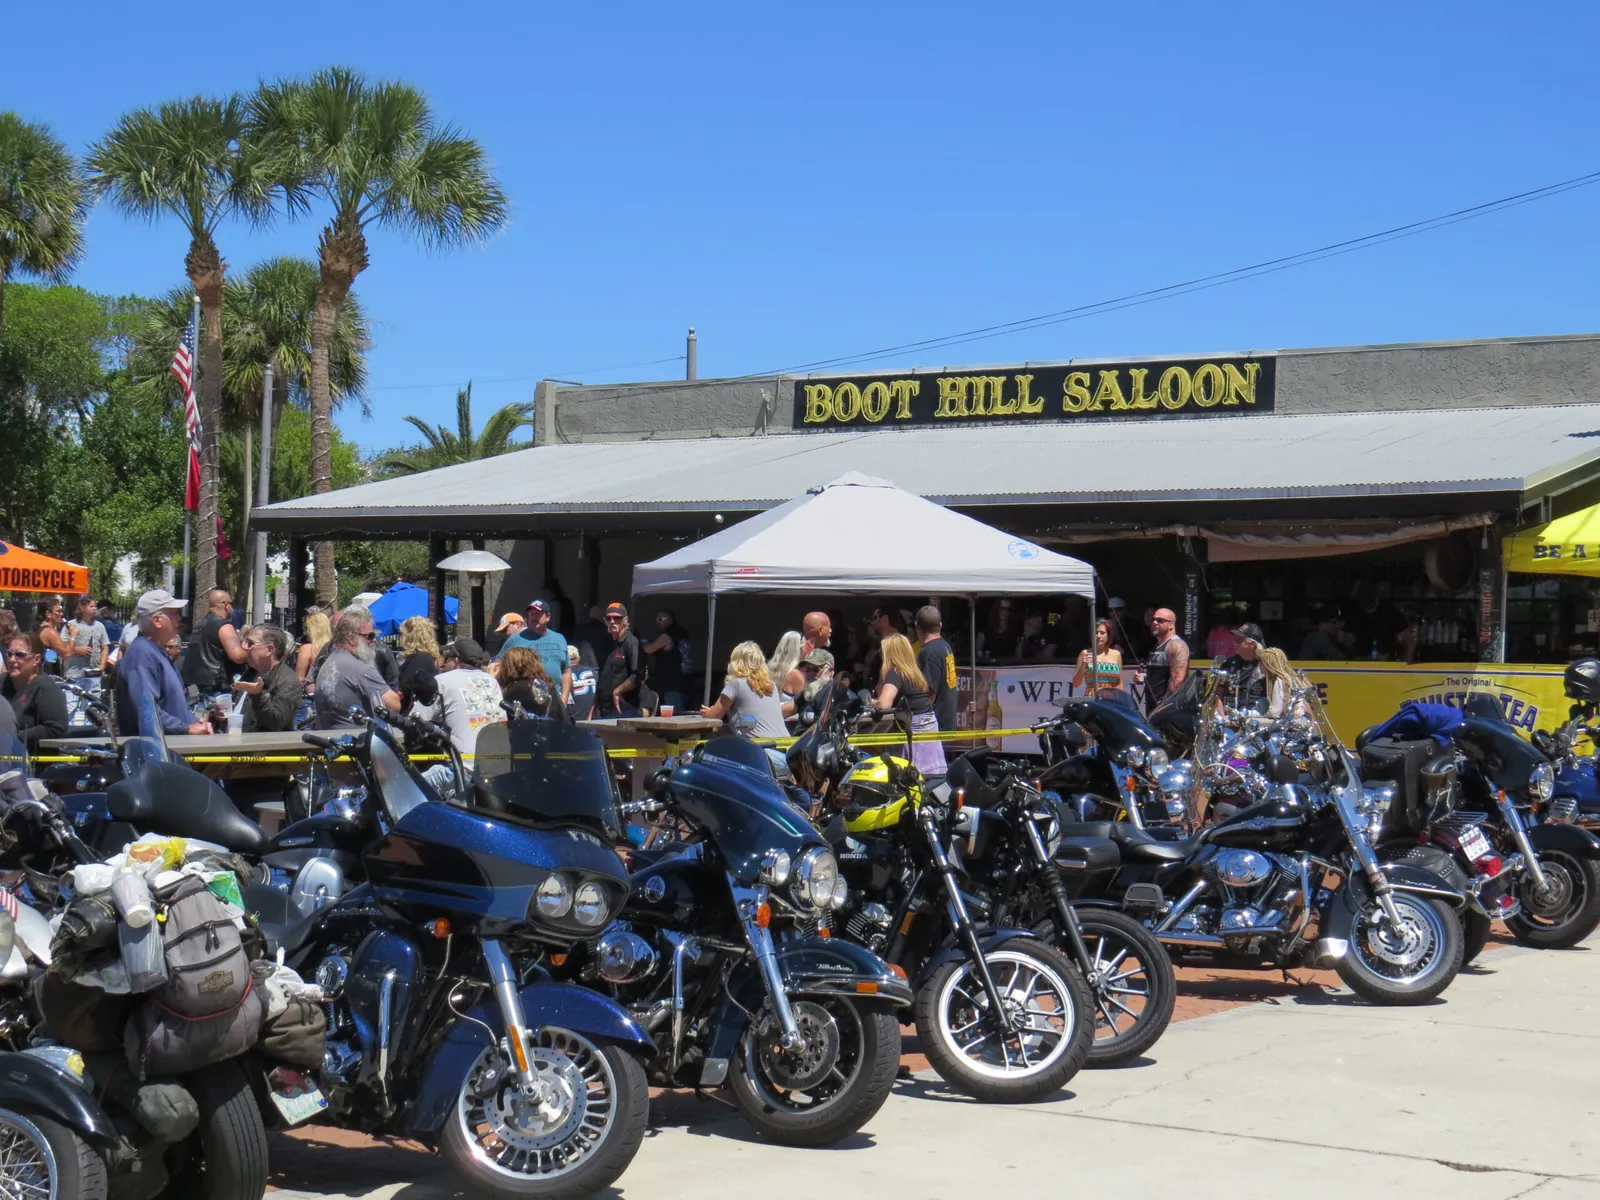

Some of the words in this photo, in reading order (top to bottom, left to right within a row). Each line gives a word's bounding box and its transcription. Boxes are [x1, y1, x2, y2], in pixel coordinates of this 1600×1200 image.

[803, 379, 920, 424] BOOT
[934, 374, 1045, 418] HILL
[1063, 362, 1261, 413] SALOON
[1532, 544, 1562, 559] BE
[1571, 544, 1587, 559] A
[0, 567, 76, 589] TORCYCLE
[1446, 676, 1461, 686] The
[1461, 676, 1492, 687] Original
[1499, 693, 1538, 733] TEA
[839, 852, 869, 860] HONDA
